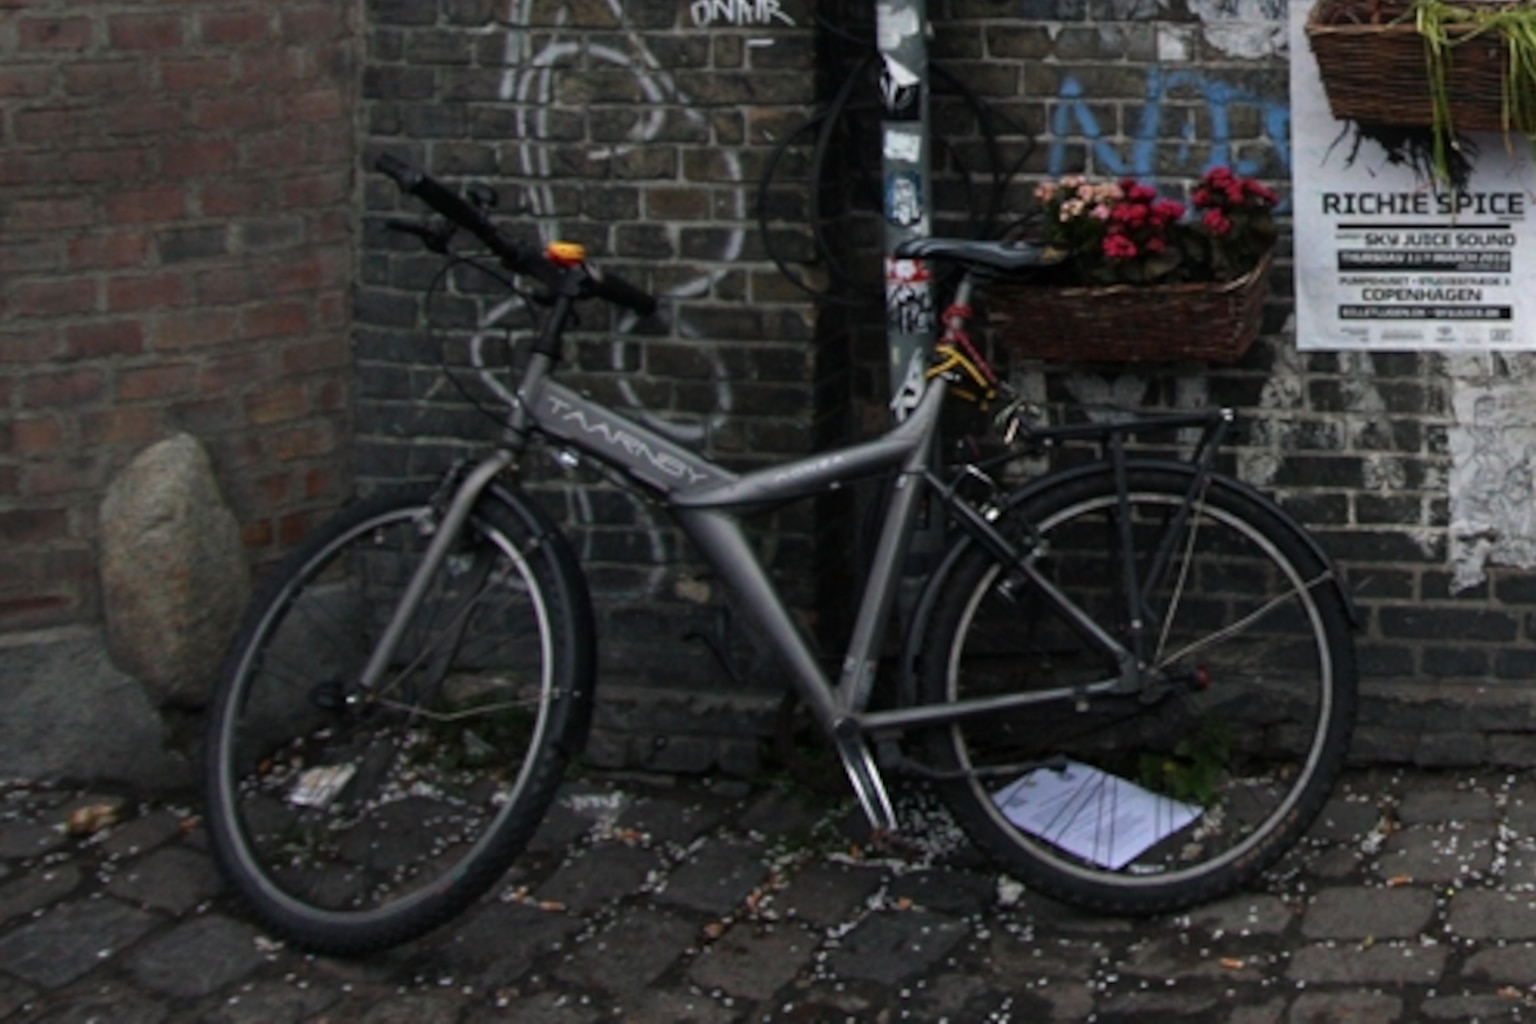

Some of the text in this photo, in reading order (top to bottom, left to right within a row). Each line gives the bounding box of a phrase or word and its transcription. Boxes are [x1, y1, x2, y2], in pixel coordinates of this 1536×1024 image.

[1321, 192, 1525, 215] RICHIE SPICE
[1364, 232, 1399, 246] SKY
[1402, 232, 1452, 246] JUICE
[1455, 232, 1517, 246] SOUND
[1361, 287, 1483, 302] COPENHAGEN
